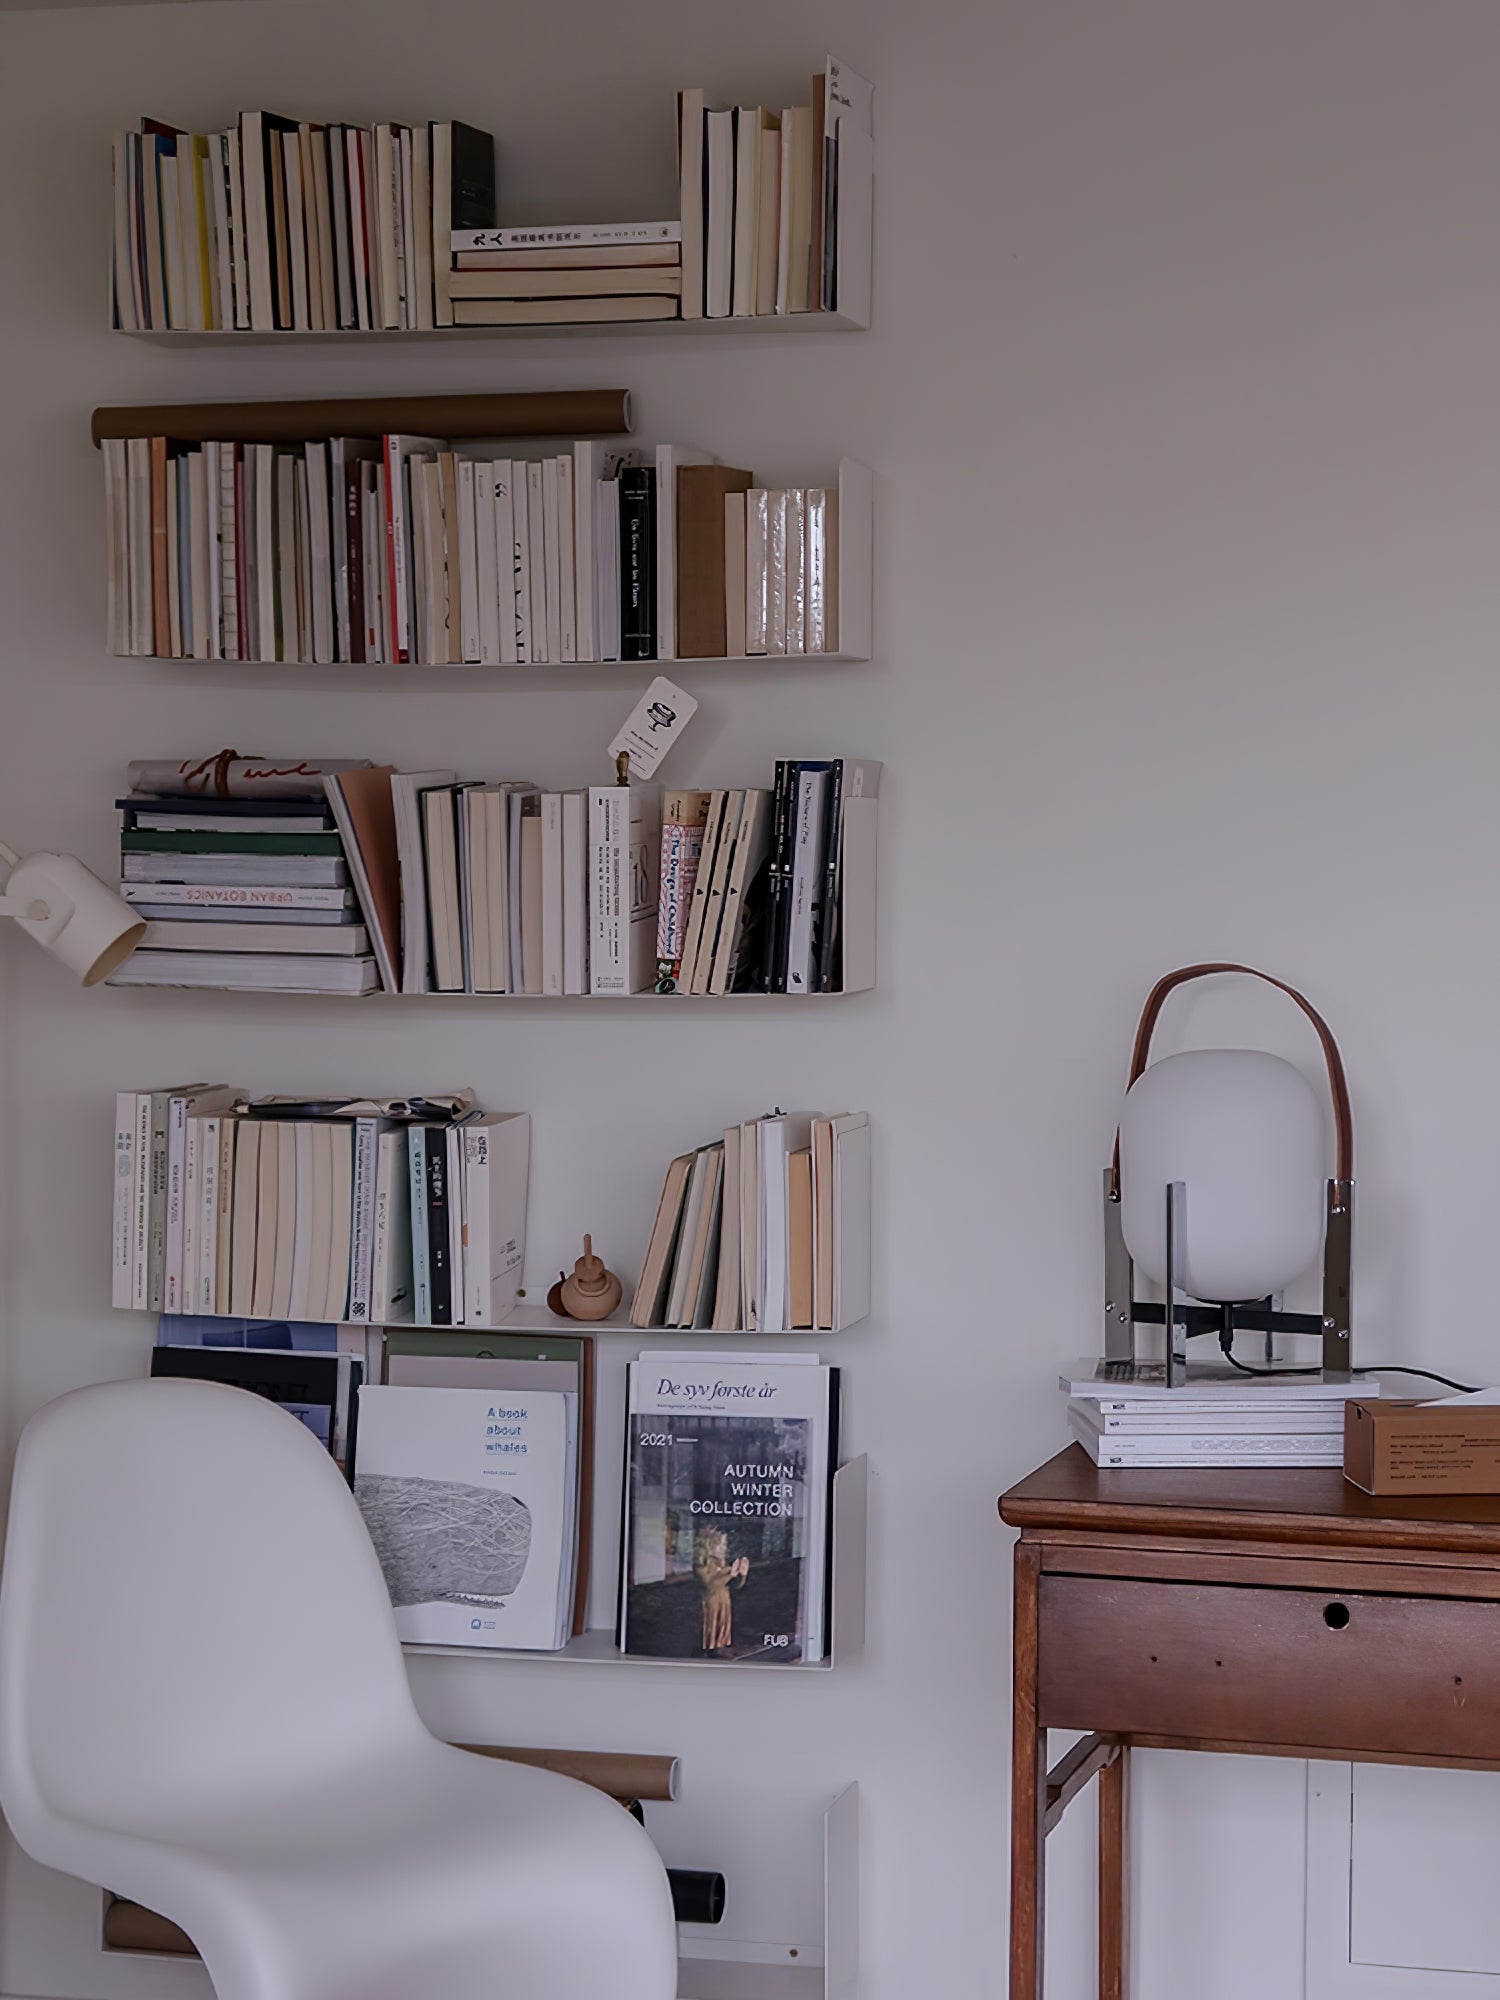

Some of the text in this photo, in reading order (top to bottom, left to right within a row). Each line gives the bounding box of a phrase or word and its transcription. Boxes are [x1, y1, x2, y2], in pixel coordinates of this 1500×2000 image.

[667, 858, 679, 890] Design
[186, 888, 293, 904] URBAN BOTANICS
[667, 905, 677, 956] Childhood
[657, 1378, 680, 1396] De
[683, 1384, 710, 1400] syv
[758, 1382, 778, 1398] år
[487, 1407, 528, 1418] A book
[486, 1424, 521, 1435] about
[639, 1432, 673, 1447] 2021
[485, 1443, 528, 1453] whales
[724, 1463, 794, 1479] AUTUMN
[731, 1482, 793, 1497] WINTER
[689, 1500, 793, 1516] COLLECTION
[763, 1634, 789, 1647] FUB
